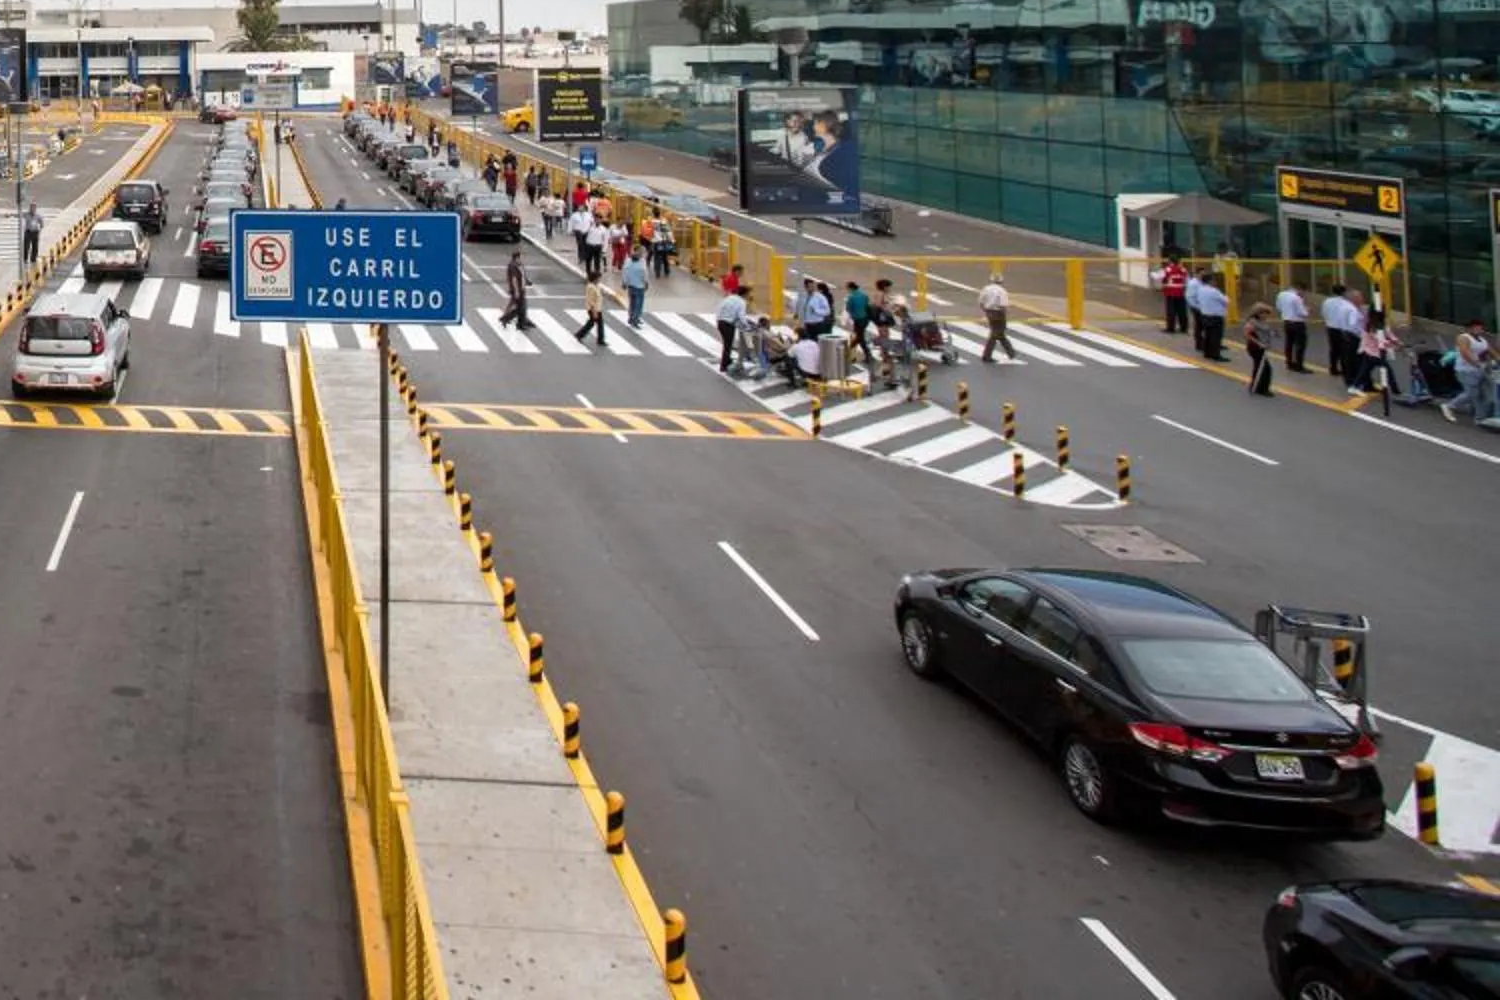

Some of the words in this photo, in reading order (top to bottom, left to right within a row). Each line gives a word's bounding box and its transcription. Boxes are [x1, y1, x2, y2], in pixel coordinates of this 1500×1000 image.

[1383, 189, 1394, 210] 2
[325, 227, 370, 248] USE
[395, 228, 423, 248] EL
[329, 258, 421, 279] CARRIL
[307, 287, 443, 310] IZQUIERDO
